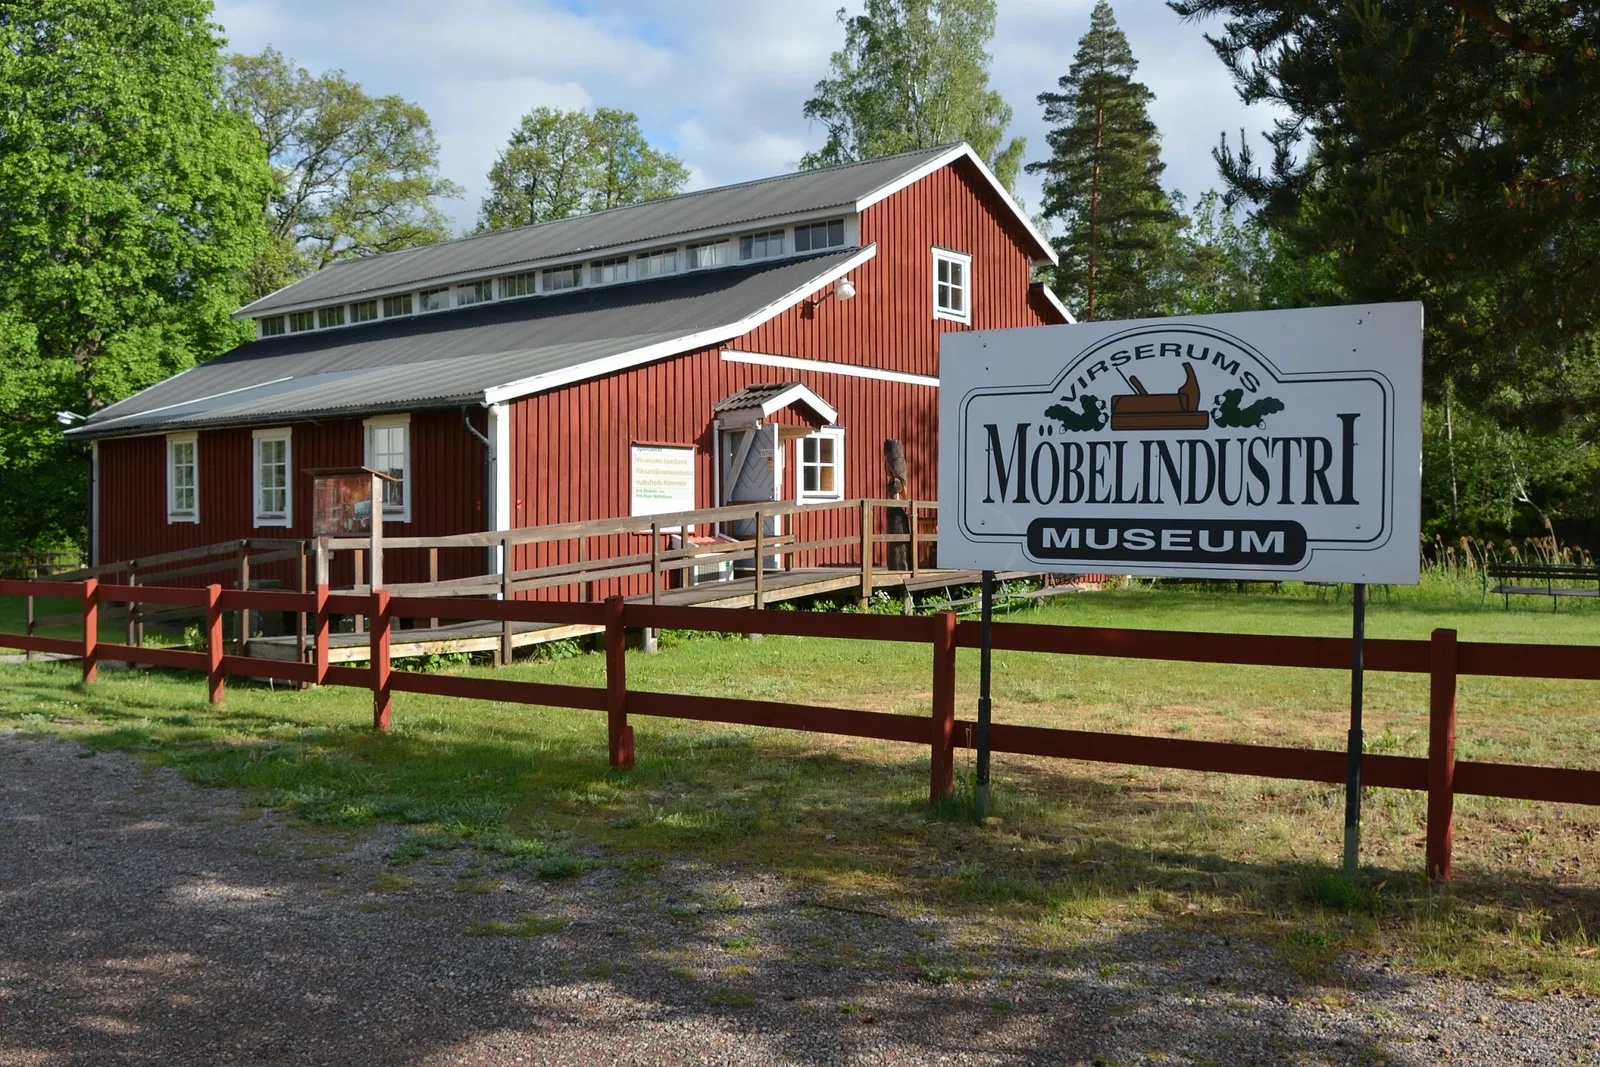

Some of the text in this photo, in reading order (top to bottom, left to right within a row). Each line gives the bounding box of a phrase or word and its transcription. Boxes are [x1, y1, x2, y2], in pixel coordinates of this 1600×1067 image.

[1060, 342, 1261, 403] VIRSERUMS
[663, 457, 688, 466] Sparbank
[983, 412, 1361, 507] MÖBELINDUSTRI
[1041, 527, 1286, 554] MUSEUM
